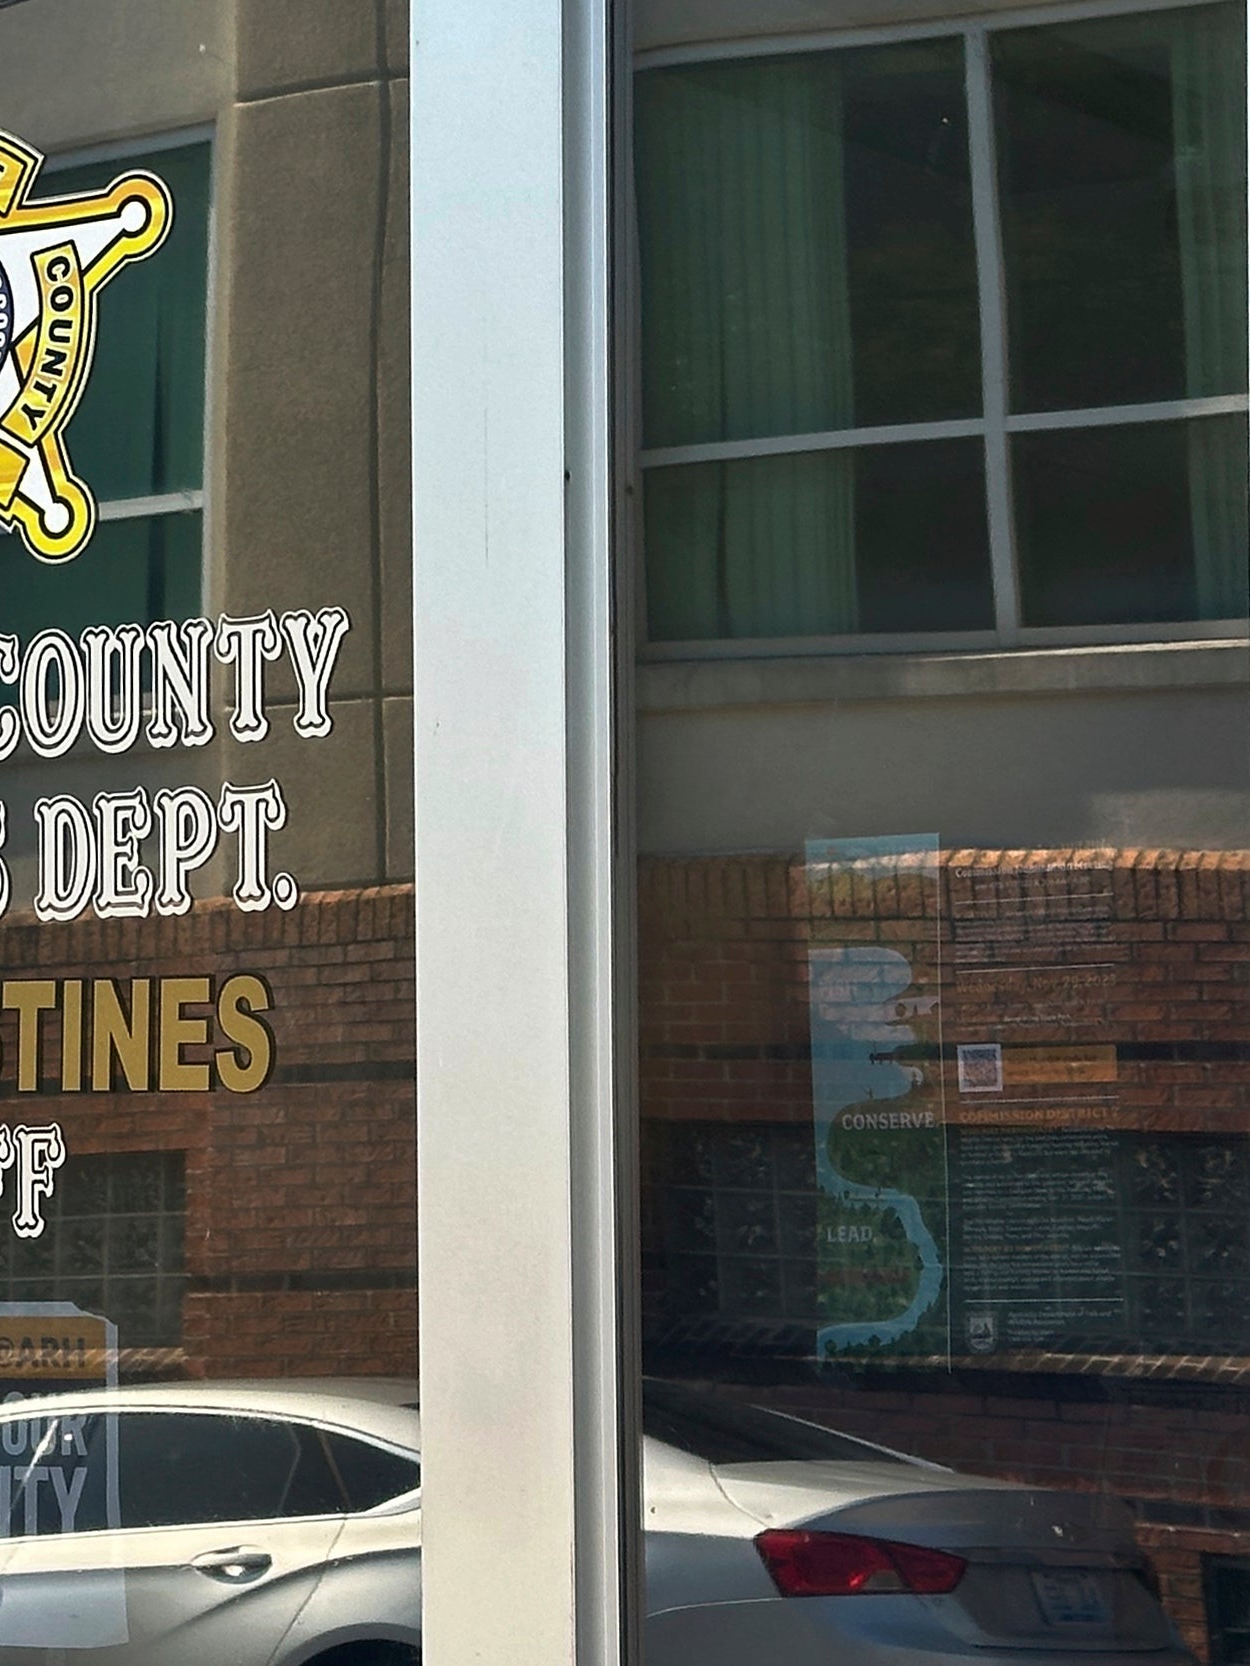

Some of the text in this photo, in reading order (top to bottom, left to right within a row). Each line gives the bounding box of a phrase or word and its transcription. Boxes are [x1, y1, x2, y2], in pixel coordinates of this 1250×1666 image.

[21, 256, 74, 431] COUNTY
[34, 779, 300, 922] DEPT.
[827, 1225, 872, 1242] LEAD
